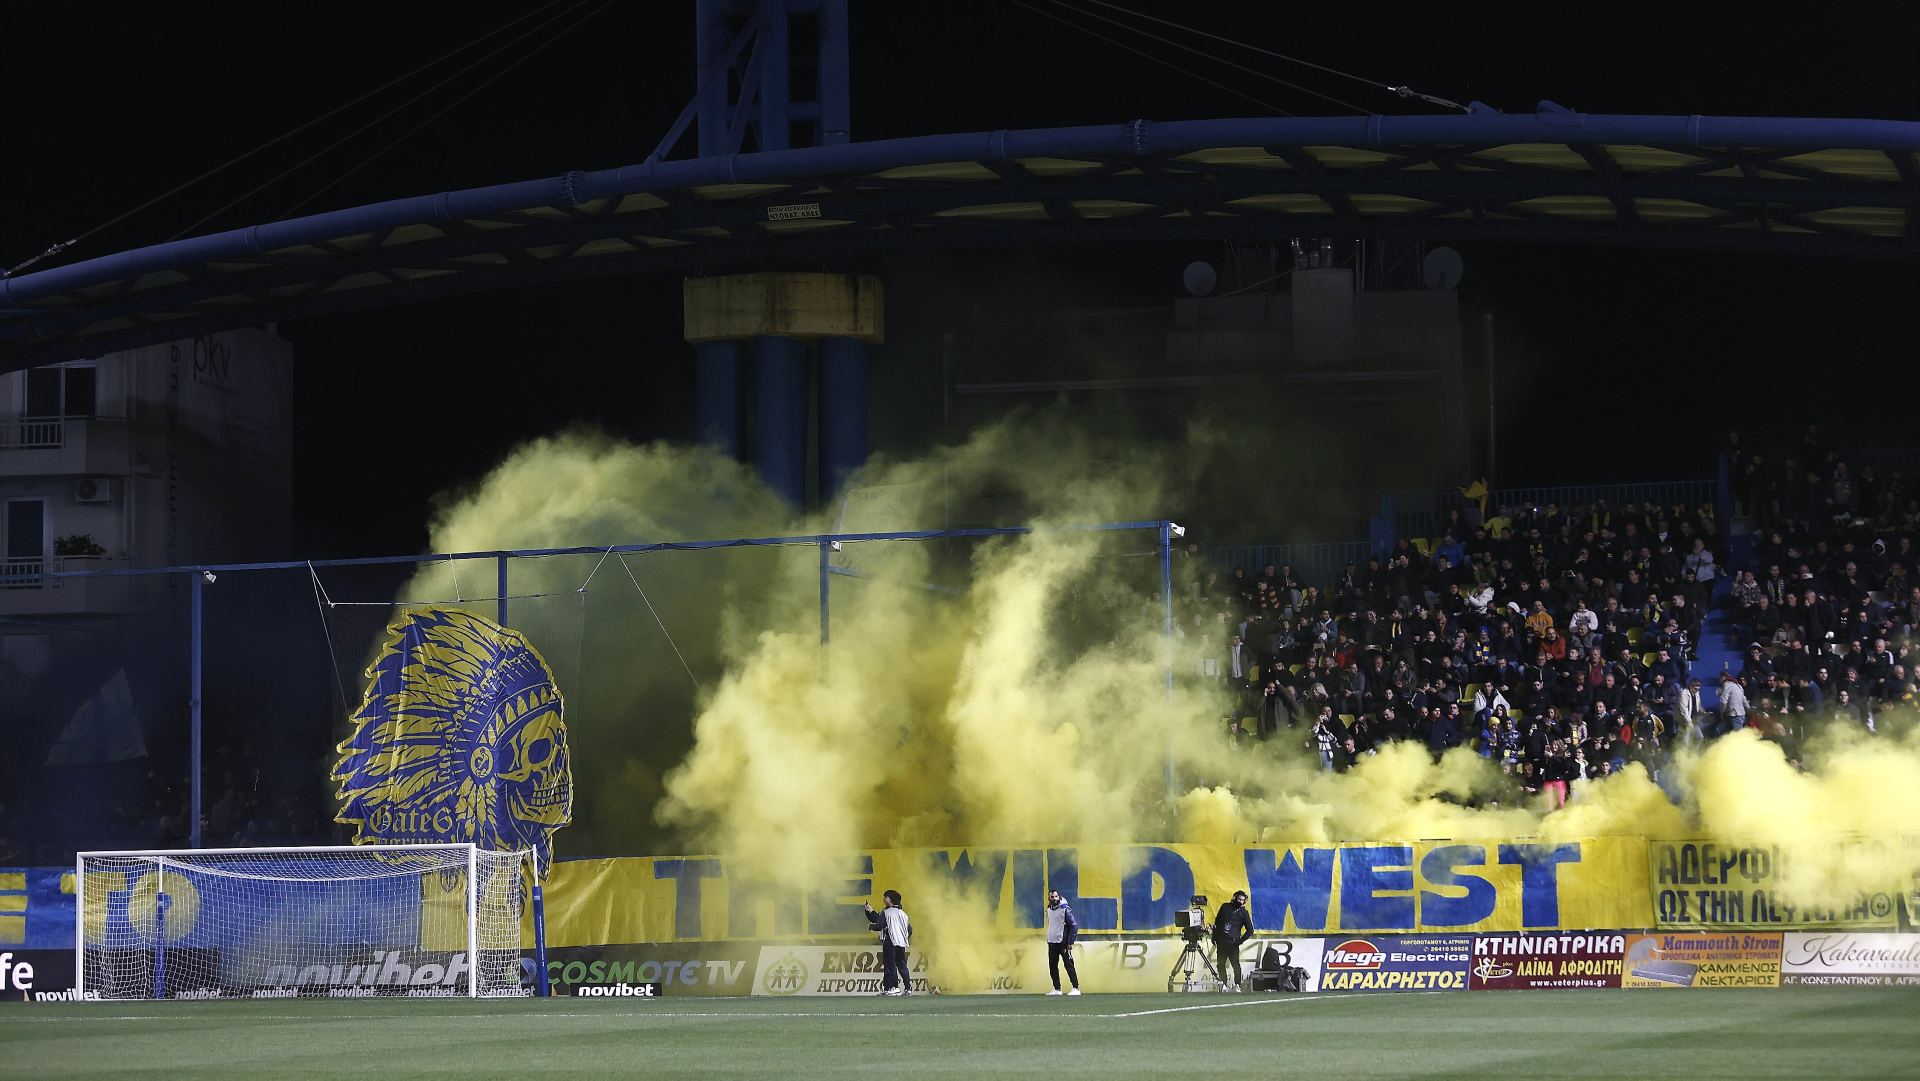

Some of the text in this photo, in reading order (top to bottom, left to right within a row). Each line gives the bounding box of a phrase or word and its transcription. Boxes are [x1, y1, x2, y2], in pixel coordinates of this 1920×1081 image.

[654, 842, 1581, 938] THE WILD WEST
[1660, 889, 1689, 923] ΩΣ
[1696, 890, 1744, 923] ΤΗΝ
[1474, 936, 1625, 955] ΚΤΗΝΙΑΤΡΙΚΑ
[1662, 935, 1780, 951] Mammouth Strom
[1323, 950, 1469, 966] Mega Electrics
[705, 960, 746, 986] TV
[1516, 957, 1622, 976] ΛΑΪΝΑ ΑΦΡΟΔΙΤΗ
[1698, 962, 1779, 973] ΚΑΜΜΕΝΟΣ
[1321, 971, 1466, 990] ΚΑΡΑΧΡΗΣΤΟΣ
[1529, 978, 1607, 987] www.veterplus.gr
[1700, 975, 1775, 986] ΝΕΚΤΑΡΙΟΣ
[1783, 976, 1798, 985] ΑΓ.
[1800, 976, 1881, 985] ΚΩΝΣΤΑΝΤΙΝΟΥ
[35, 987, 100, 1001] noviet
[330, 986, 375, 997] novibet
[408, 985, 455, 997] novibet
[578, 983, 654, 997] novibet
